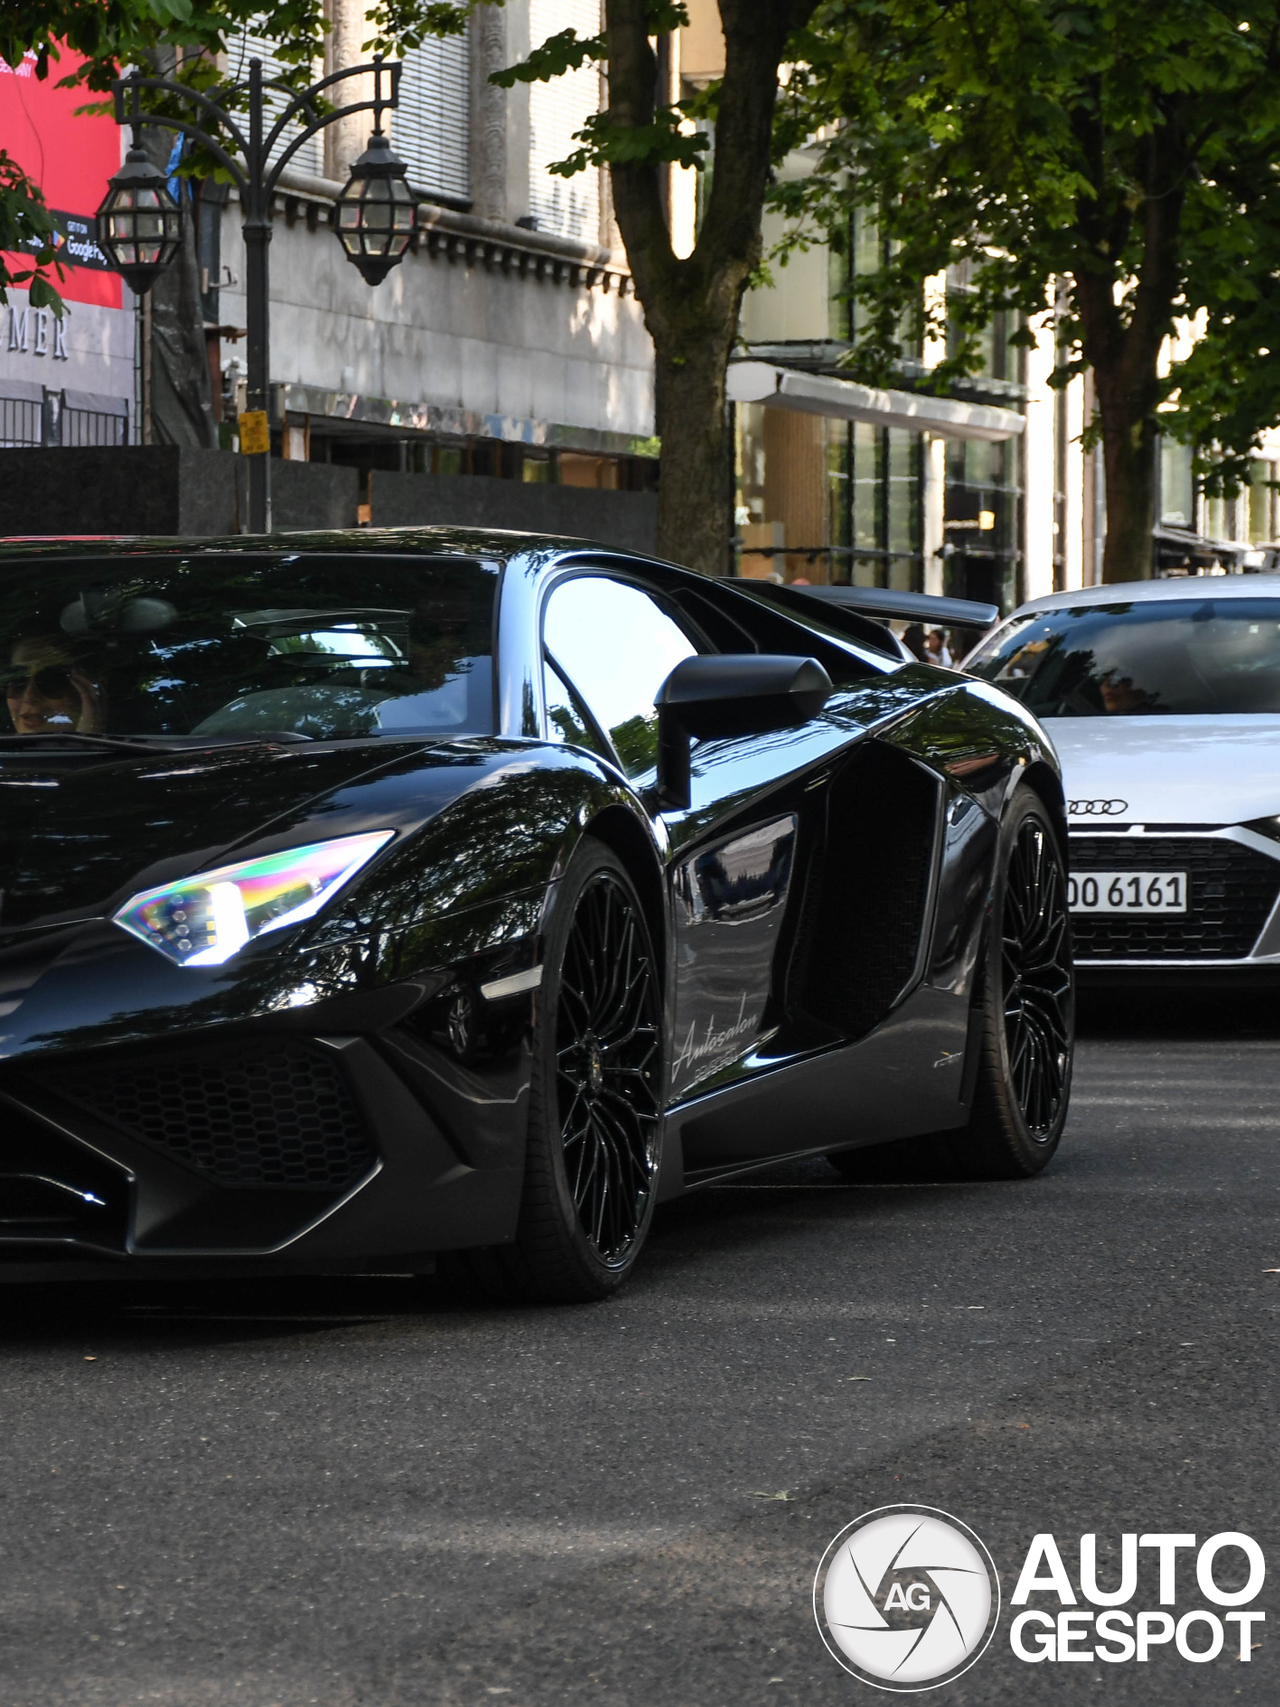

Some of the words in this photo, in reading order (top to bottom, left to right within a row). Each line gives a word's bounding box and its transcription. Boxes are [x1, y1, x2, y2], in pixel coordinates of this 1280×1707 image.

[67, 234, 93, 262] Google
[1108, 877, 1183, 907] 6161
[672, 991, 758, 1084] Autosalon
